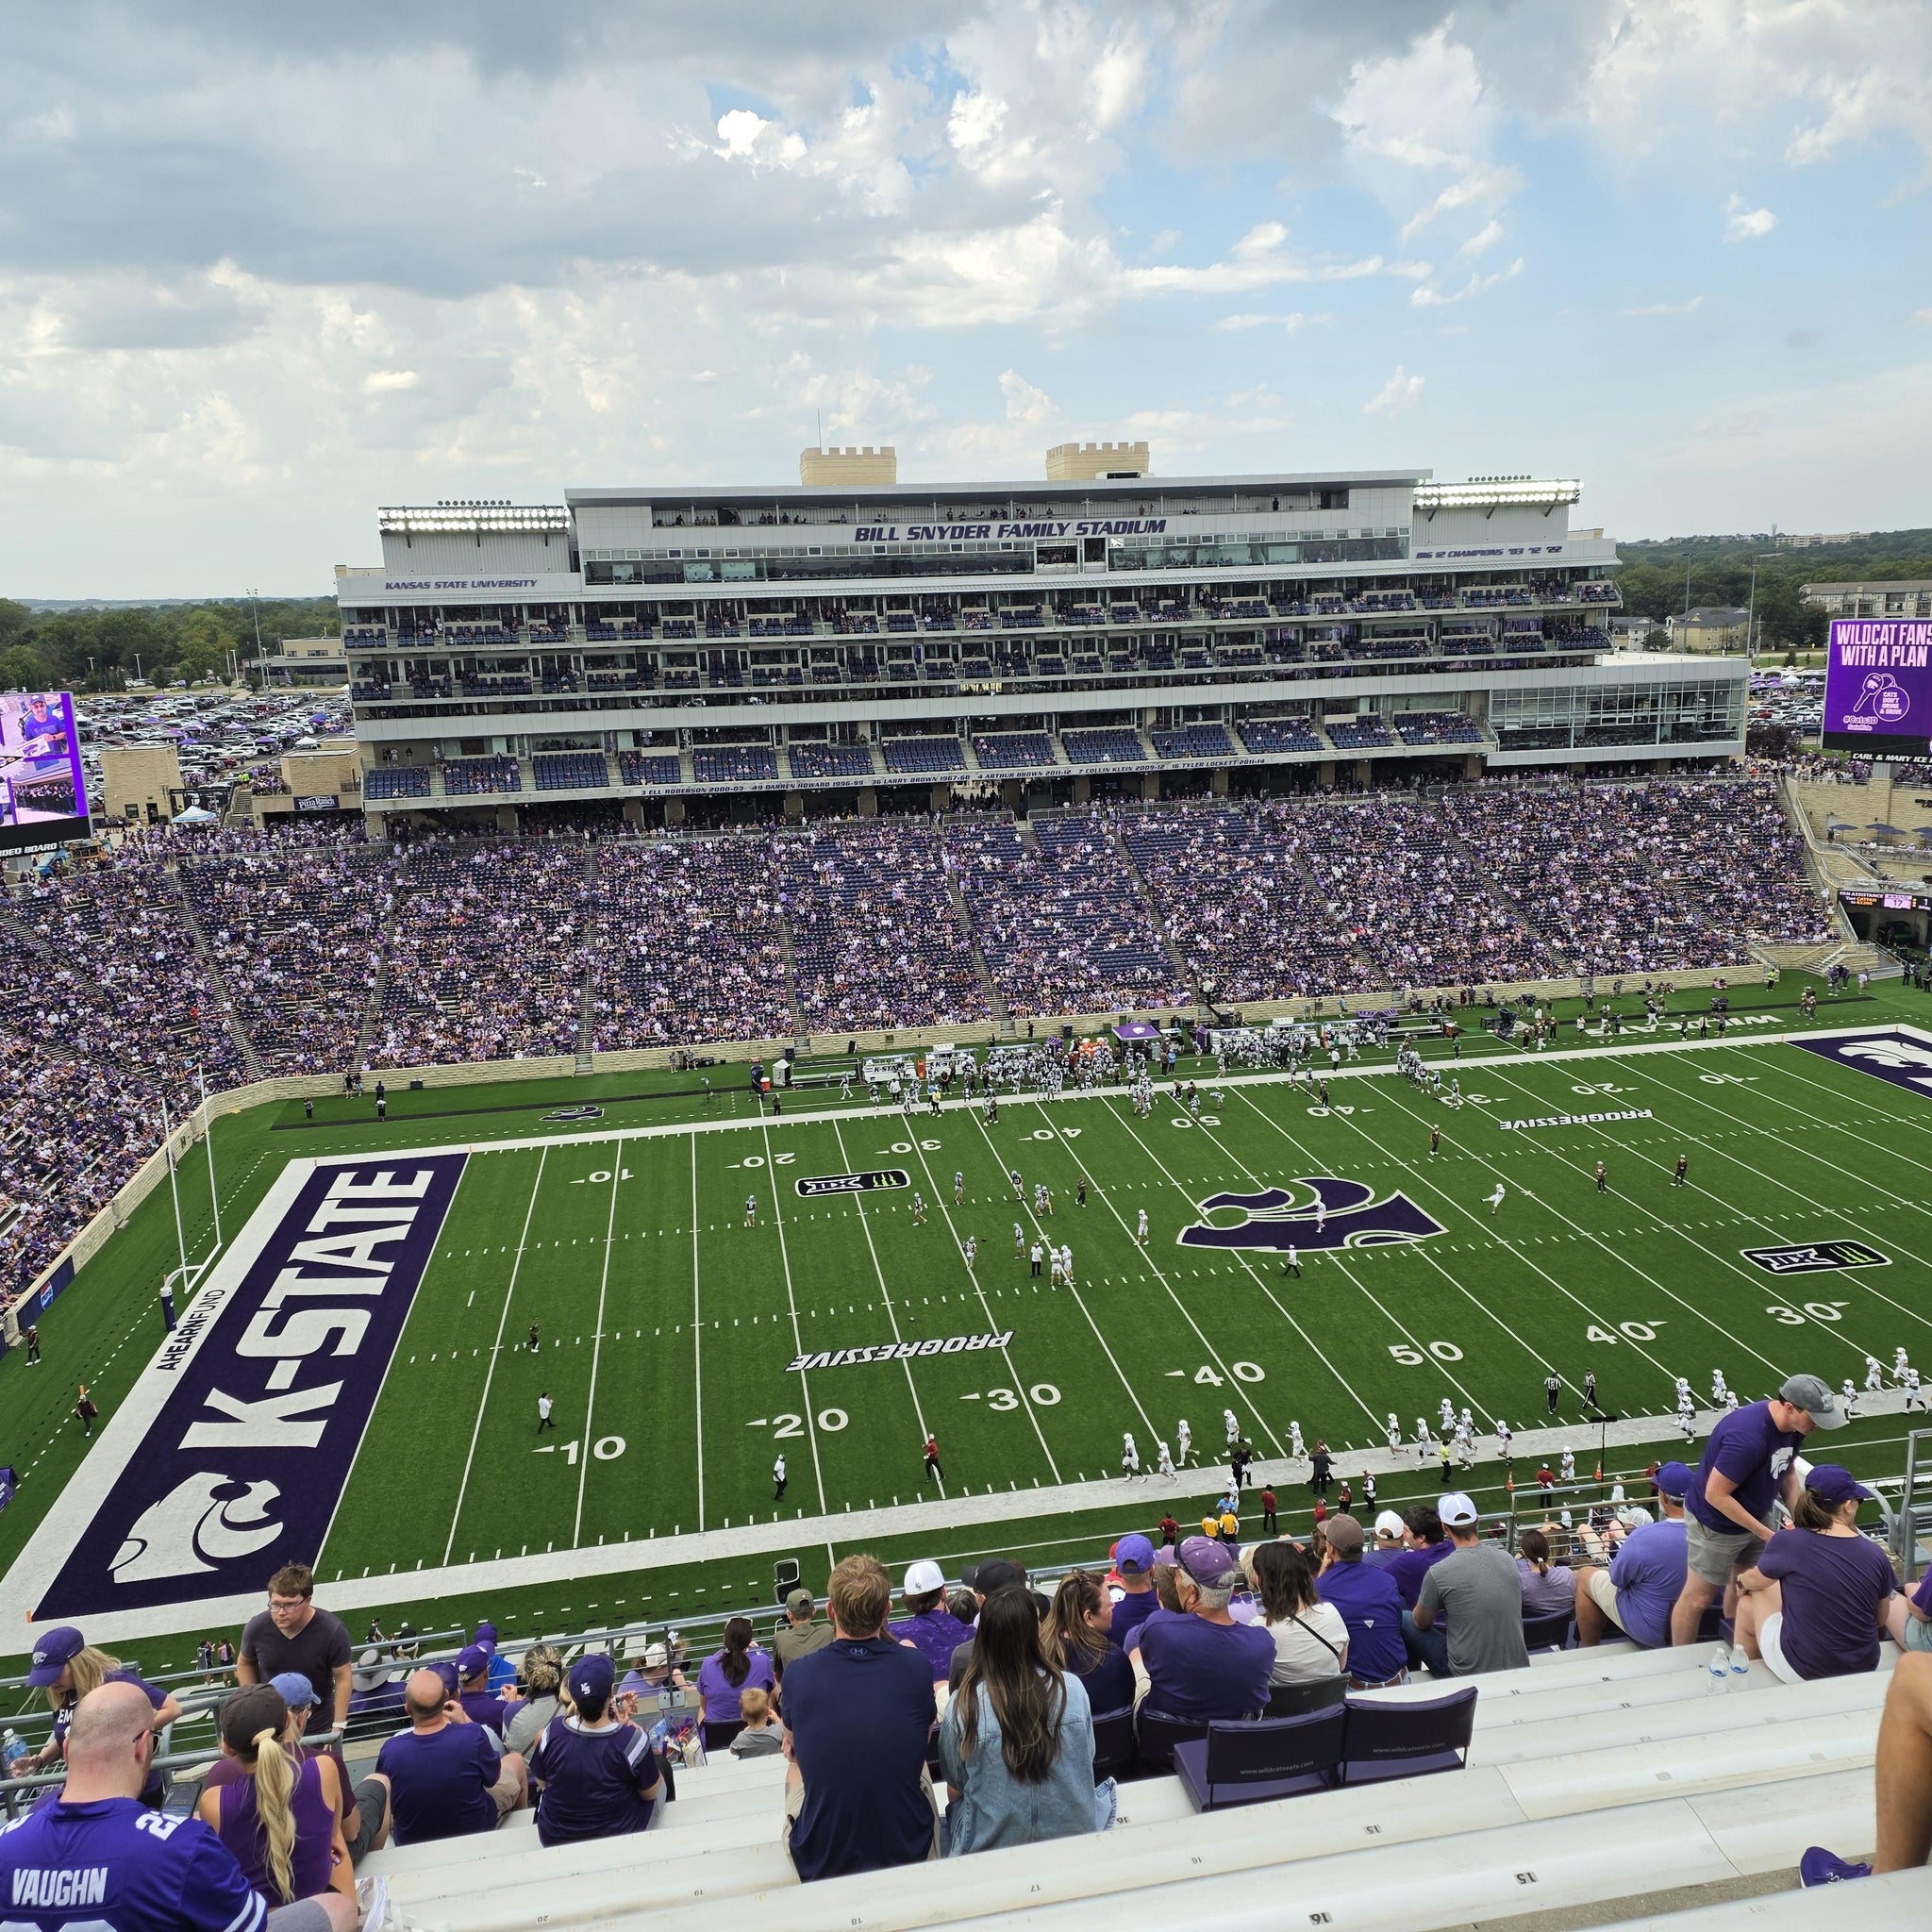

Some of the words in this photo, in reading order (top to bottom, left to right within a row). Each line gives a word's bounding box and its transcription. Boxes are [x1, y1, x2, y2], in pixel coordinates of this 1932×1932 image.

[855, 526, 899, 541] BILL
[906, 525, 991, 541] SNYDER
[997, 523, 1071, 538] FAMILY
[1075, 519, 1166, 535] STADIUM
[1448, 549, 1504, 558] CHAMPIONS
[385, 581, 430, 590] KANSAS
[471, 579, 537, 588] UNIVERSITY
[1837, 624, 1897, 645] WILDCAT
[1899, 624, 1932, 645] FANS
[1841, 646, 1877, 666] WITH
[1878, 646, 1888, 666] A
[1890, 646, 1928, 667] PLAN
[299, 800, 315, 808] Pizza
[0, 847, 22, 857] DEO
[24, 843, 57, 853] BOARD
[1698, 1073, 1748, 1085] 10
[1571, 1082, 1625, 1095] 20
[1441, 1093, 1492, 1106] 30
[1307, 1105, 1357, 1117] 40
[1171, 1116, 1222, 1129] 50
[1499, 1108, 1654, 1130] PROGRESSIVE
[1032, 1126, 1083, 1141] 40
[891, 1139, 942, 1154] 30
[743, 1152, 797, 1168] 20
[589, 1168, 635, 1183] 10
[177, 1170, 435, 1449] K-STATE
[1766, 1301, 1843, 1326] 30
[1586, 1321, 1657, 1345] 40
[785, 1330, 1017, 1372] PROGRESSIVE
[1388, 1341, 1464, 1366] 50
[1194, 1362, 1266, 1386] 40
[988, 1384, 1062, 1412] 30
[772, 1408, 849, 1439] 20
[560, 1436, 627, 1465] 10
[58, 1708, 73, 1724] EM
[1373, 1742, 1445, 1753] www.wildcatseats.com
[1240, 1761, 1314, 1775] www.wildcatseats.com
[1116, 1816, 1129, 1824] 16
[1366, 1825, 1381, 1834] 15
[1516, 1871, 1537, 1884] 15
[12, 1867, 108, 1907] VAUGHN
[1030, 1884, 1041, 1892] 17
[537, 1915, 549, 1923] 20
[851, 1917, 863, 1926] 18
[1310, 1912, 1330, 1925] 16
